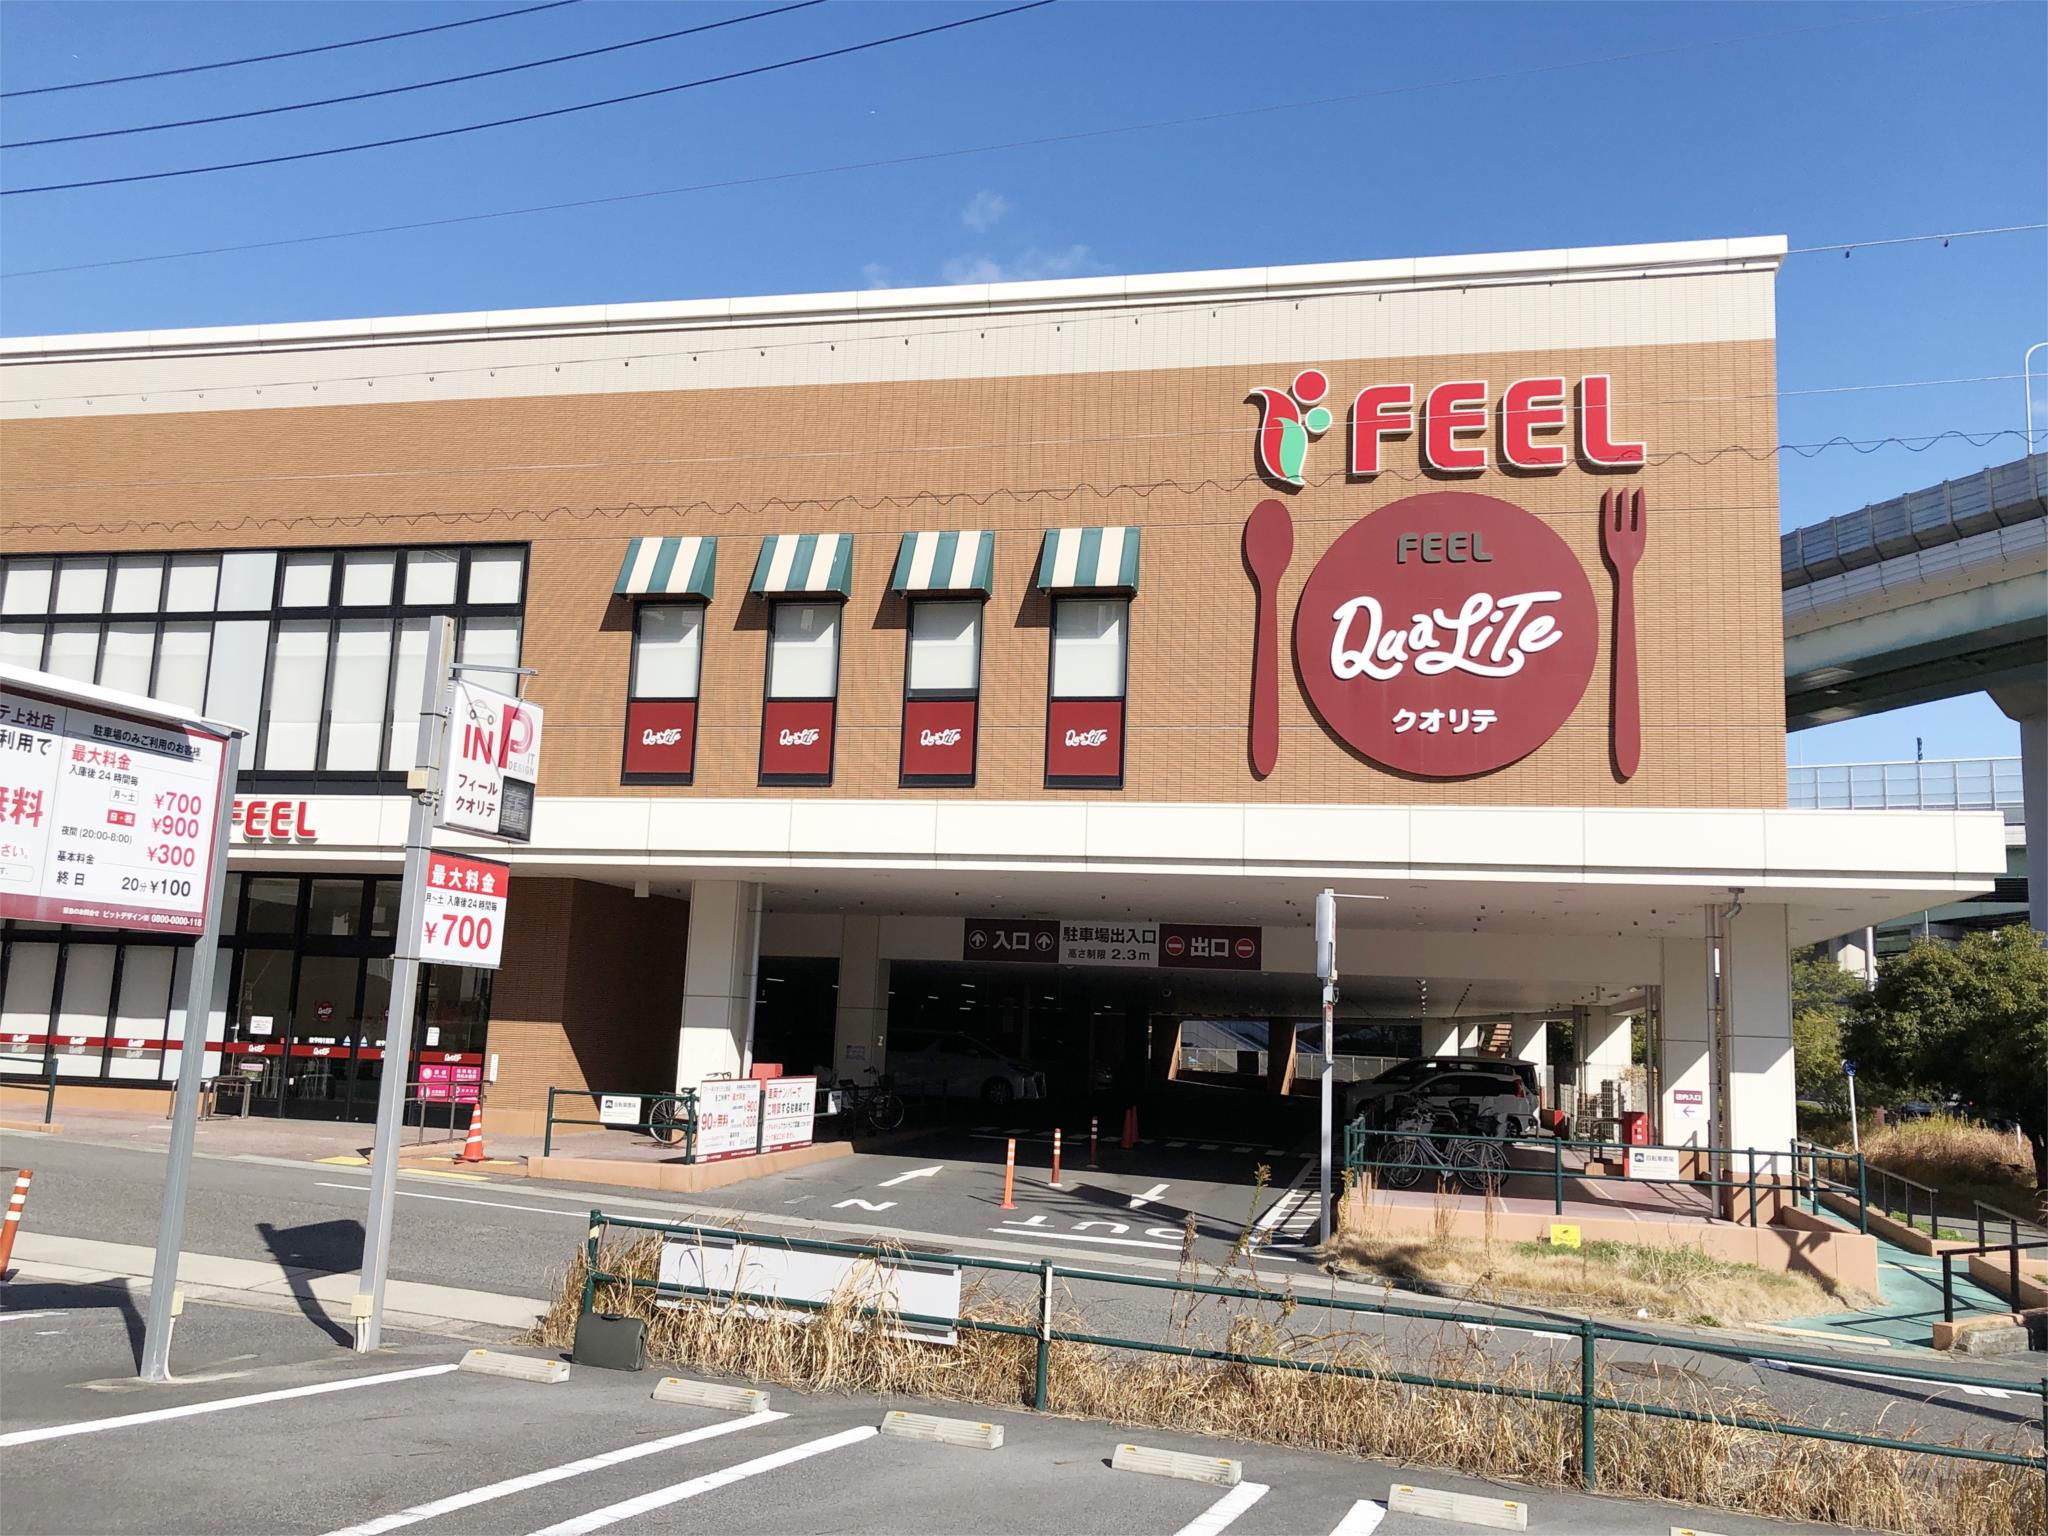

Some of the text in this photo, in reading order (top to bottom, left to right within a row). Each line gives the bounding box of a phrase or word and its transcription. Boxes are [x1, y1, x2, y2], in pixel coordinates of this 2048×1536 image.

[1352, 374, 1647, 475] FEEL
[1397, 531, 1494, 564] FEEL
[1392, 707, 1498, 734] クオリテ
[93, 724, 201, 757] 駐車場のみご利用のお客様
[463, 724, 494, 765] IN
[72, 743, 132, 771] 最大料金
[458, 774, 498, 796] フィール
[154, 791, 202, 815] ¥700
[455, 796, 496, 818] クオリテ
[151, 815, 199, 838] ¥900
[57, 850, 95, 865] 基本料金
[147, 844, 195, 867] ¥300
[150, 878, 191, 897] ¥100
[431, 863, 496, 893] 最大料金
[424, 914, 492, 949] ¥700
[992, 930, 1030, 950] 入口
[1062, 926, 1157, 945] 駐車場出入口
[1111, 948, 1150, 961] 2.3m
[1190, 936, 1230, 958] 出口
